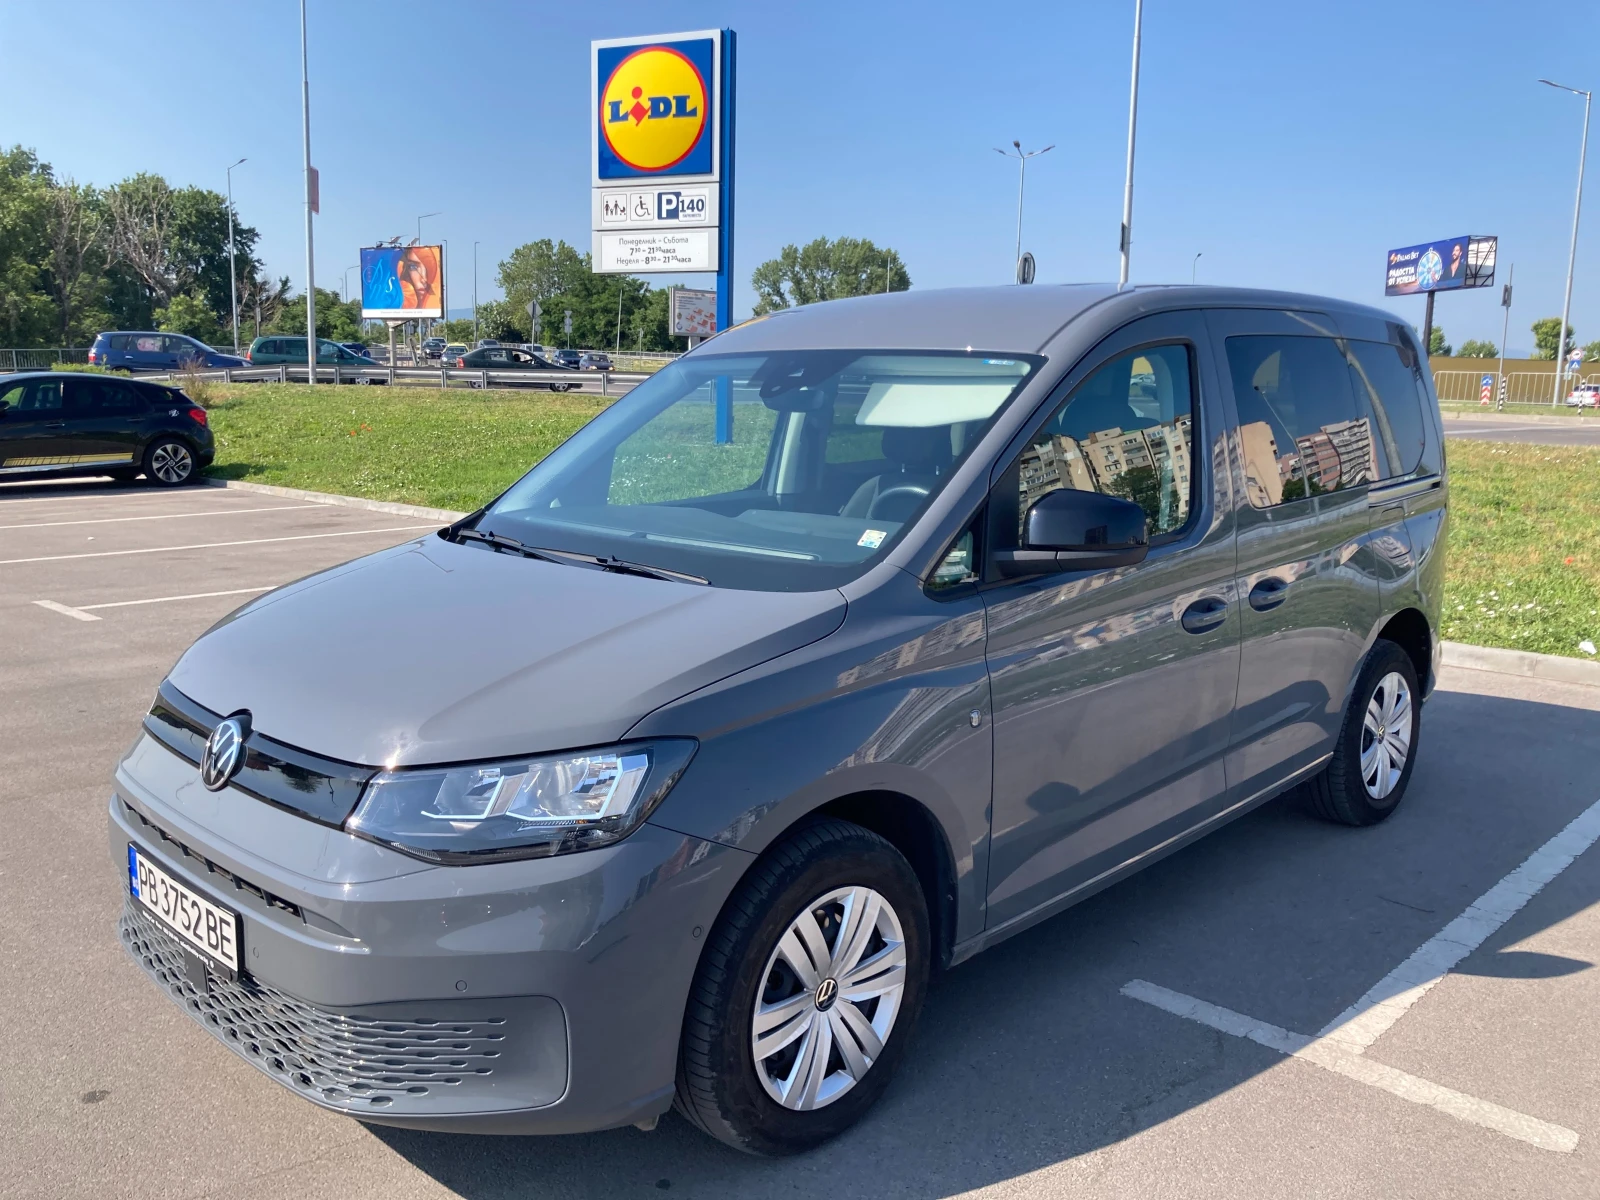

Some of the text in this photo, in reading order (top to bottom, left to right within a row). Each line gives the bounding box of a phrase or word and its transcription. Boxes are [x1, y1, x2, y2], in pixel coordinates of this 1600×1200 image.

[661, 194, 704, 218] P 140
[663, 236, 689, 244] Събота
